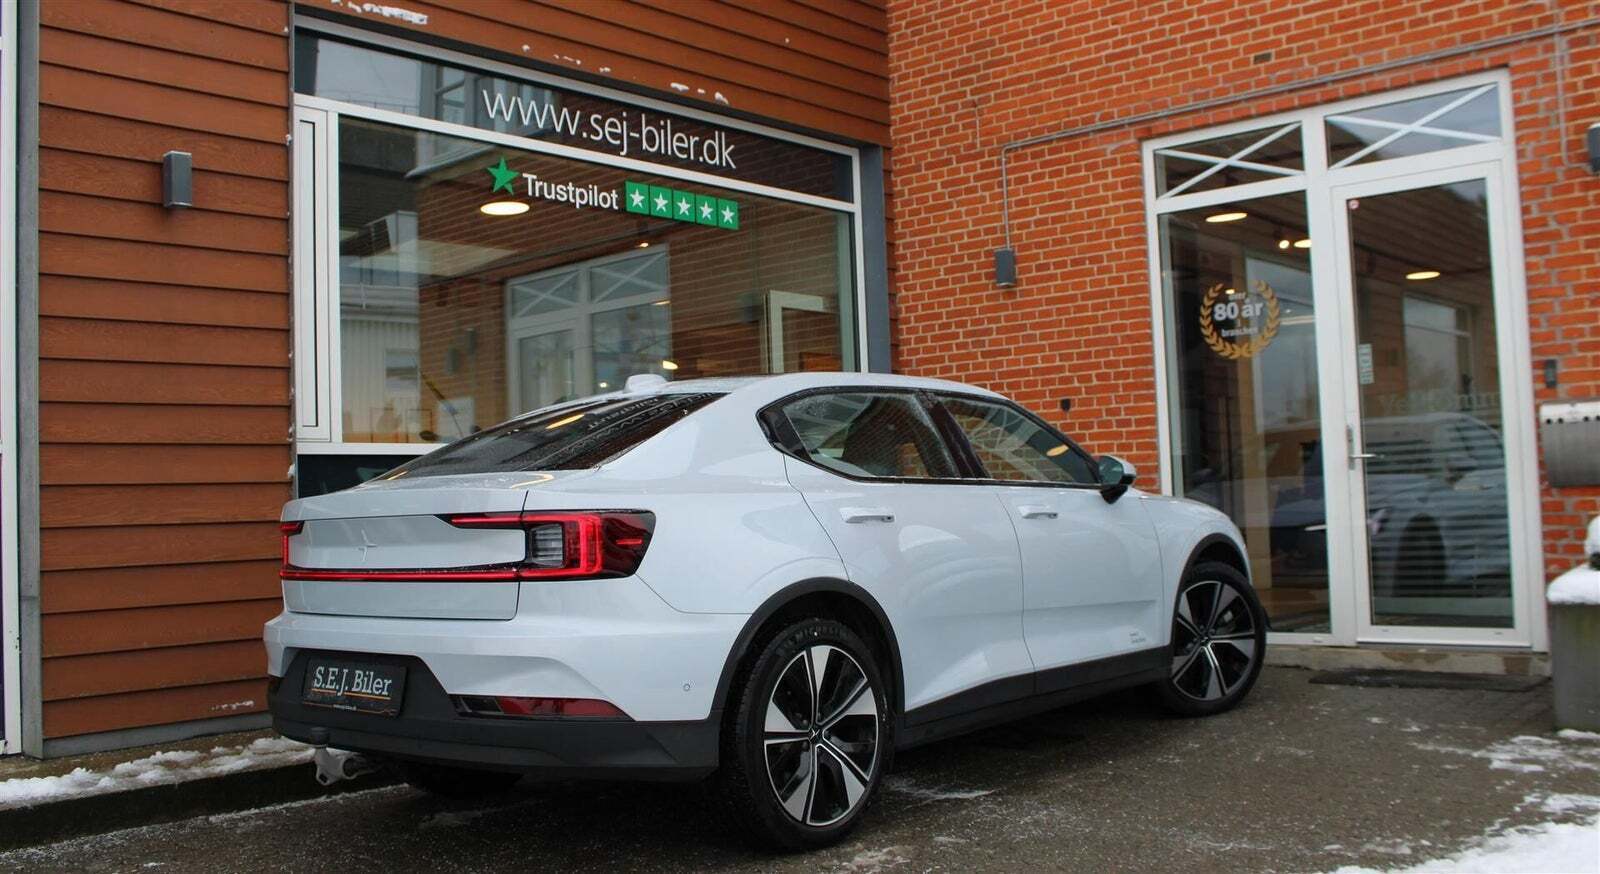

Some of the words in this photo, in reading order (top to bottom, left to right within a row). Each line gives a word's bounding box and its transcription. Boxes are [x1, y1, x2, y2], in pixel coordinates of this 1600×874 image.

[482, 89, 737, 169] www.sej-biler.dk
[522, 172, 620, 210] Trustpilot
[1214, 303, 1238, 320] 80
[1242, 298, 1263, 317] år
[313, 666, 348, 695] S.E.J.
[352, 669, 391, 695] Biler
